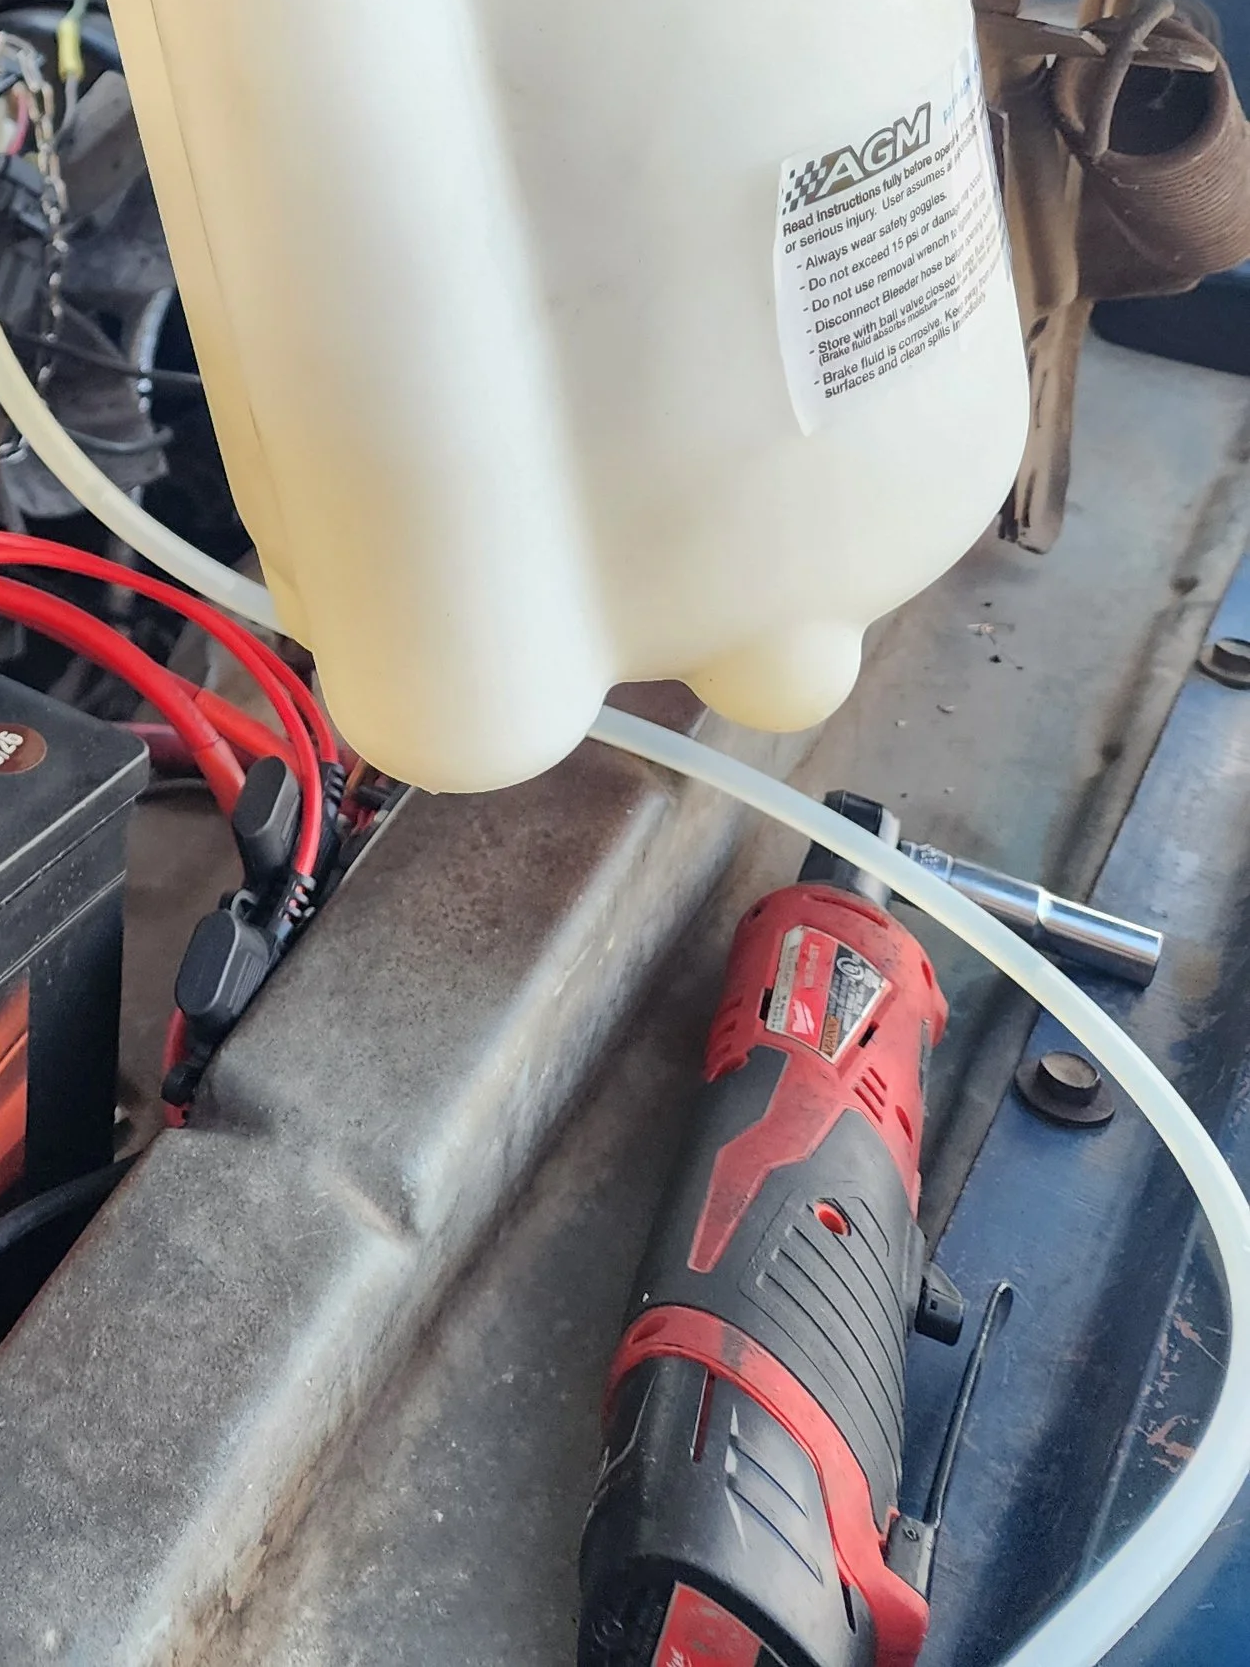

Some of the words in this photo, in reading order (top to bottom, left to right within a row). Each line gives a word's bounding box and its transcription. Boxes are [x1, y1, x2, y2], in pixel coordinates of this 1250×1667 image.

[805, 102, 931, 207] AGM
[783, 214, 814, 237] Read
[816, 184, 882, 221] Instructions
[882, 173, 903, 194] fully
[903, 155, 933, 178] before
[785, 241, 796, 254] or
[799, 223, 844, 247] serious
[845, 207, 877, 230] injury.
[881, 191, 905, 210] User
[906, 169, 946, 197] assumes
[806, 246, 848, 271] Always
[850, 234, 877, 252] wear
[879, 214, 909, 237] safety
[909, 192, 948, 222] goggles.
[808, 275, 827, 291] Do
[830, 265, 849, 284] not
[852, 247, 890, 274] exceed
[892, 238, 904, 253] 15
[905, 229, 920, 249] psi
[920, 222, 931, 235] or
[812, 297, 830, 313] Do
[833, 285, 853, 305] not
[855, 278, 875, 295] use
[877, 253, 916, 285] removal
[916, 234, 950, 261] wrench
[815, 300, 881, 335] Disconnect
[882, 278, 920, 303] Bleeder
[920, 262, 943, 282] hose
[818, 334, 851, 354] Store
[853, 321, 878, 340] with
[879, 308, 899, 328] ball
[899, 295, 925, 316] valve
[925, 275, 957, 302] closed
[818, 345, 850, 366] (Brake
[851, 335, 872, 353] fluid
[873, 316, 907, 342] absorbs
[822, 362, 859, 386] Brake
[860, 350, 885, 370] fluid
[886, 344, 897, 356] is
[898, 317, 943, 350] corrosive.
[824, 370, 876, 399] surfaces
[877, 360, 898, 376] and
[899, 343, 927, 365] clean
[927, 325, 952, 347] spills
